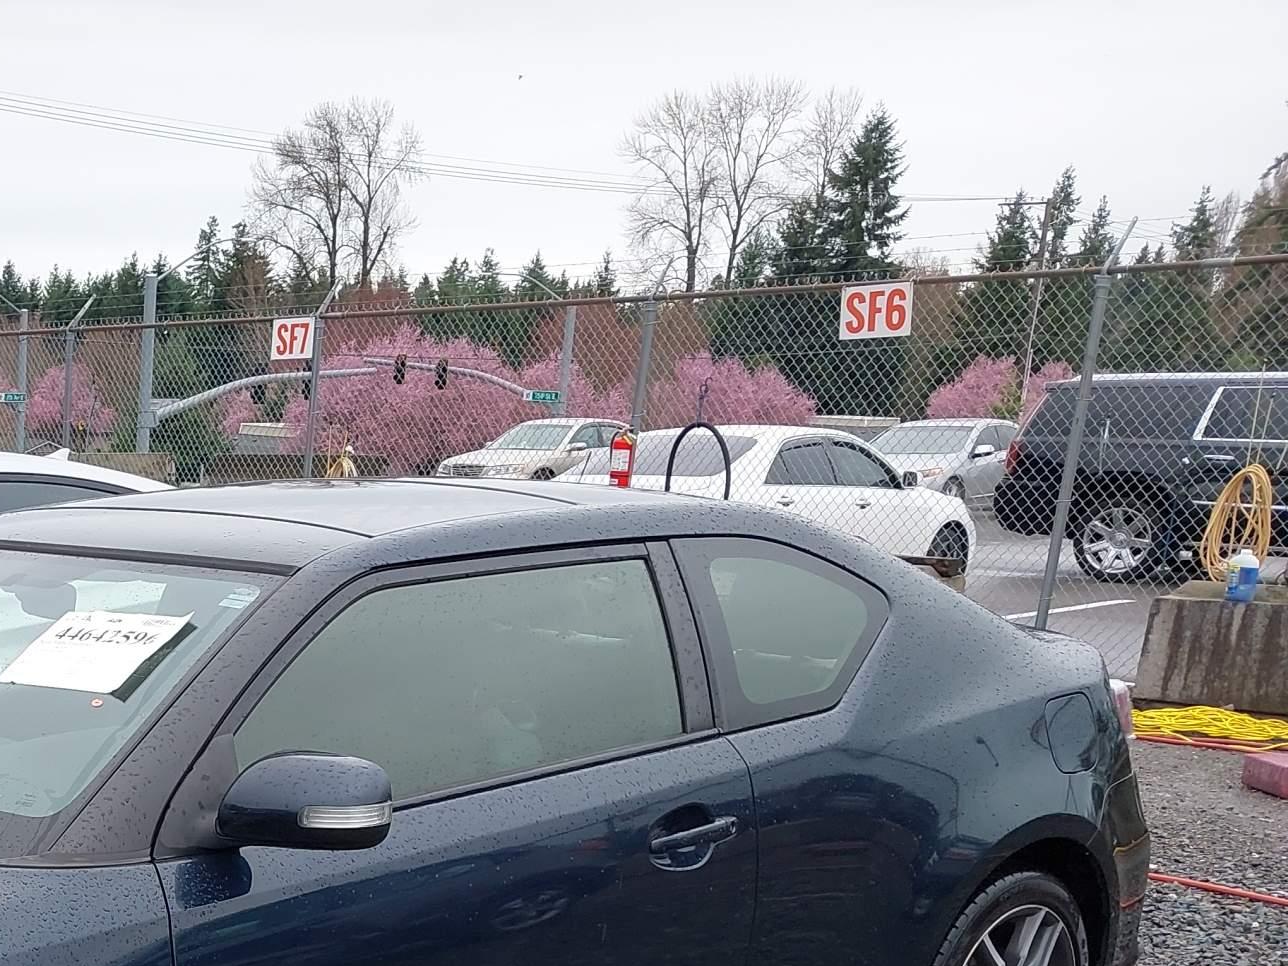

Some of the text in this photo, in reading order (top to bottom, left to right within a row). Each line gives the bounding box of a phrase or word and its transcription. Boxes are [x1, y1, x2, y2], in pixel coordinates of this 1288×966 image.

[845, 288, 907, 334] SF6
[276, 323, 310, 356] SF7
[55, 626, 161, 646] 44642596
